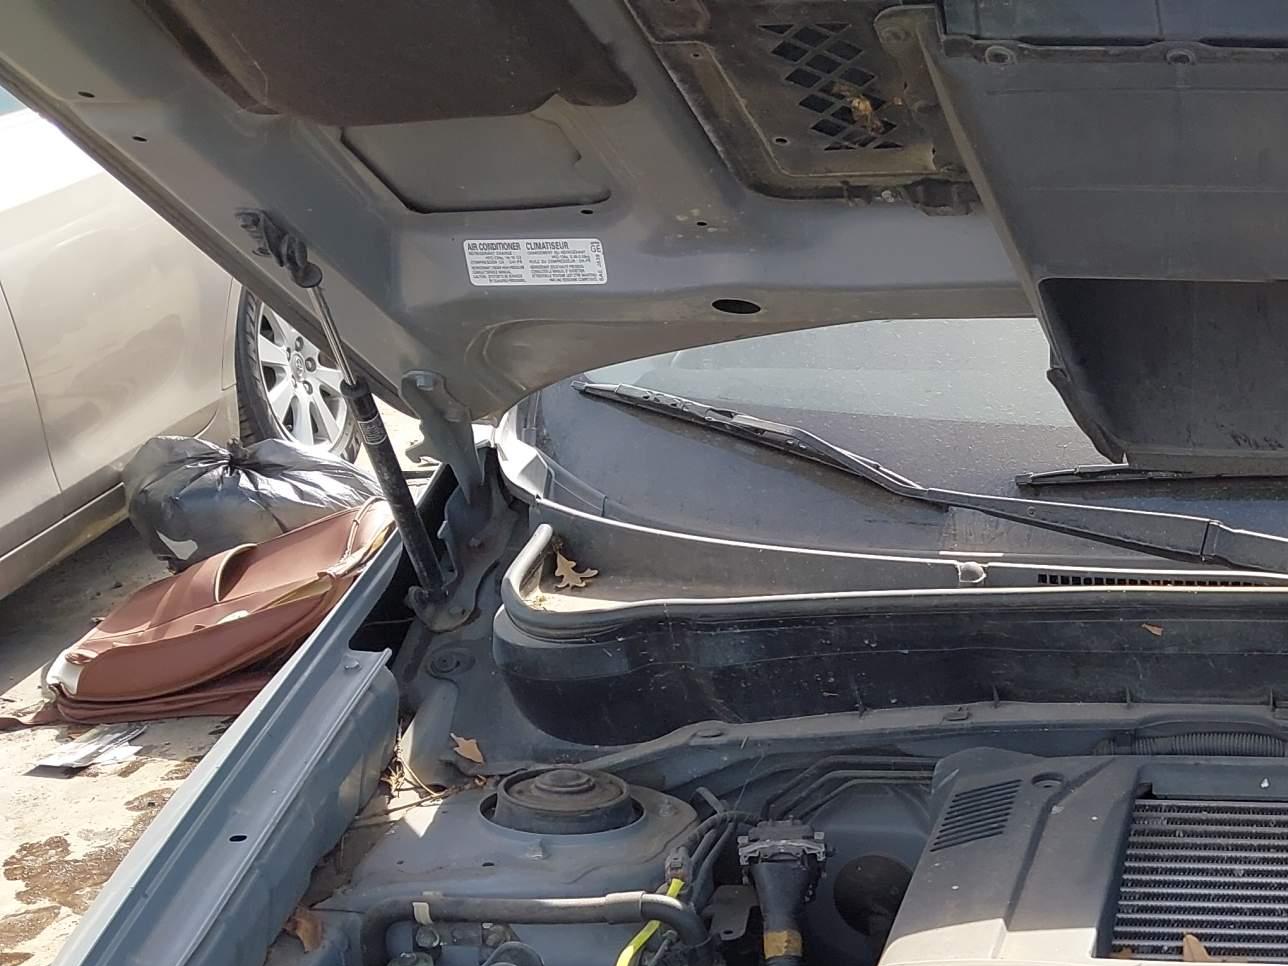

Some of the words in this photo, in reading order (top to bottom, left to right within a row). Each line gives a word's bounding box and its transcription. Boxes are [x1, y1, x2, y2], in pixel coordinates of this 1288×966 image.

[467, 242, 478, 250] AIR
[478, 242, 521, 250] CONDITIONER
[526, 241, 569, 250] CLIMATISEUR
